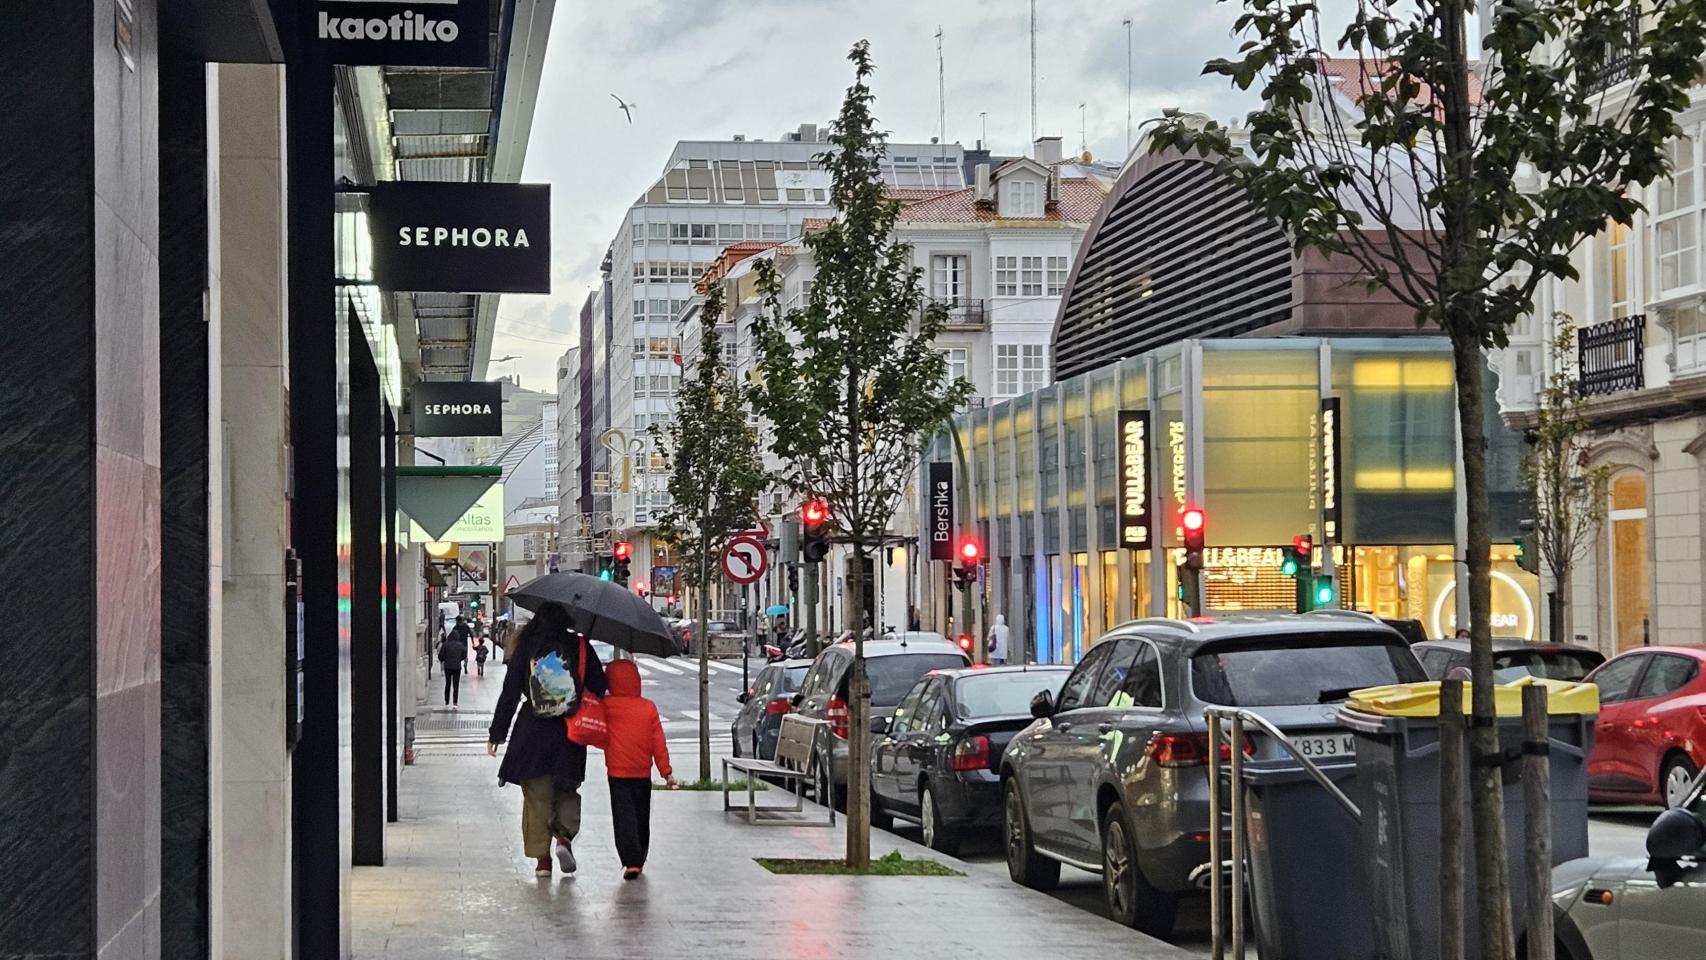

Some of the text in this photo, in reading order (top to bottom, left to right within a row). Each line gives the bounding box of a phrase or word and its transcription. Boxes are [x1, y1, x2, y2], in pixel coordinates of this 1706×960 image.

[318, 9, 459, 42] kaotiko
[399, 226, 530, 248] SEPHORA
[424, 403, 492, 415] SEPHORA
[1124, 419, 1146, 516] PULL&BEAR
[458, 513, 492, 525] Altas
[933, 481, 949, 542] Bershka
[1294, 738, 1337, 756] 833
